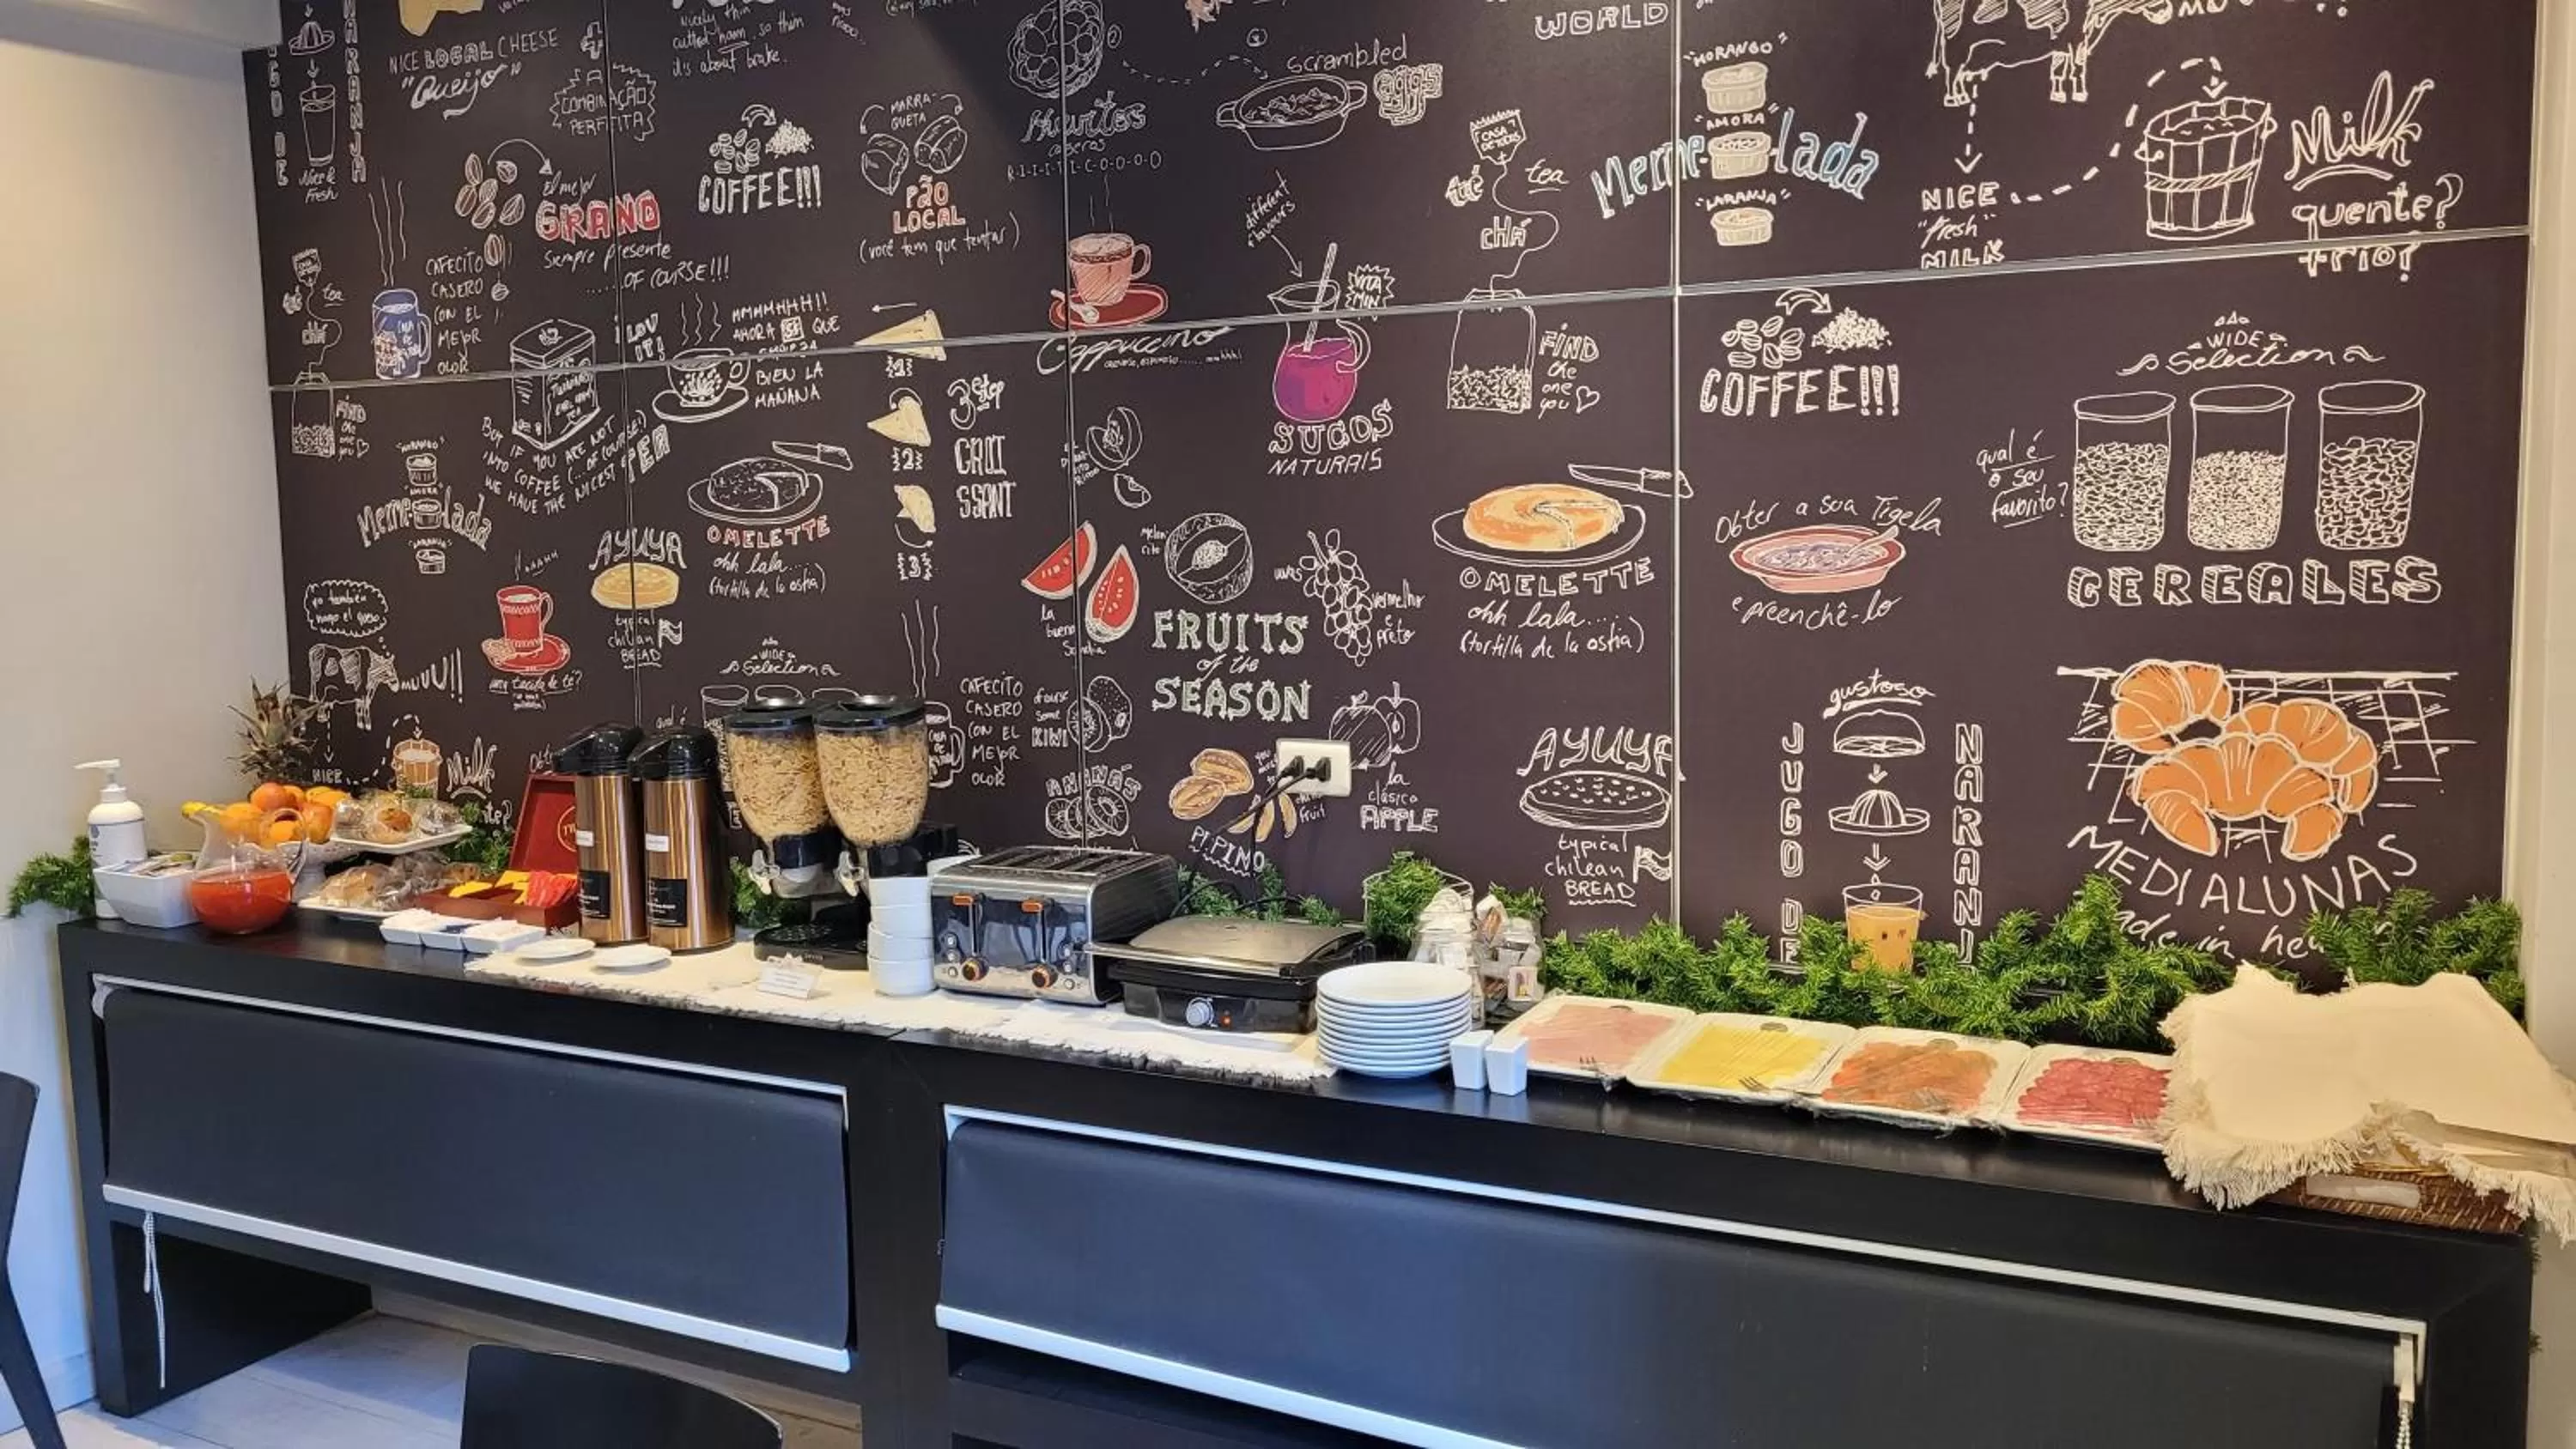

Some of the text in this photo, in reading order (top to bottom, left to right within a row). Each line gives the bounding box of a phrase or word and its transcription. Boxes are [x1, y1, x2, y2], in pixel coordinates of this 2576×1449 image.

[1535, 3, 1668, 39] WORLD
[389, 27, 558, 74] NICE LOCAL CHEESE
[1288, 34, 1408, 74] scrambled
[2283, 70, 2435, 181] Milk
[1525, 158, 1570, 184] tea
[697, 165, 822, 215] COFFEE!!!
[1922, 181, 2001, 211] NICE
[535, 189, 661, 246] GRANO
[893, 205, 966, 234] LOCAL
[2292, 173, 2464, 240] quente?
[1921, 239, 2006, 269] MILK
[432, 282, 483, 298] CASERO
[466, 307, 482, 322] EL
[812, 315, 841, 335] QUE
[2207, 330, 2265, 349] WIDE
[805, 361, 823, 380] LA
[2166, 342, 2336, 376] Selection
[1542, 381, 1572, 397] one
[1700, 364, 1900, 418] COFFEE!!!
[1268, 398, 1394, 457] SUCOS
[1267, 448, 1382, 476] NATURAIS
[1976, 429, 2014, 472] qual
[515, 468, 561, 496] COFFEE
[2012, 466, 2044, 486] seu
[1992, 482, 2069, 523] favorito?
[707, 514, 831, 549] OMELETTE
[1715, 500, 1779, 543] Obter
[1795, 502, 1808, 516] a
[1872, 495, 1942, 536] Tigela
[1460, 557, 1656, 598] OMELETTE
[2068, 556, 2441, 608] CEREALES
[1732, 597, 1743, 611] e
[608, 630, 654, 648] chilan
[1151, 609, 1309, 655] FRUITS
[1532, 636, 1555, 659] de
[1564, 629, 1581, 653] la
[1196, 654, 1259, 682] of the
[960, 671, 1024, 696] CAFECITO
[966, 700, 1023, 718] CASERO
[1151, 676, 1313, 723] SEASON
[968, 724, 1021, 740] CON EL
[1031, 726, 1069, 748] KIWI
[972, 745, 1021, 773] MEJOR
[1388, 760, 1411, 785] la
[972, 772, 1005, 786] OLOR
[1781, 722, 1804, 877] JUGO
[1360, 804, 1439, 833] APPLE
[1558, 830, 1628, 854] typical
[1953, 723, 1983, 969] NARANJ
[1545, 856, 1625, 880] chilean
[2067, 824, 2418, 918] MEDIALUNAS
[1565, 881, 1636, 900] BREAD
[2196, 924, 2235, 959] in
